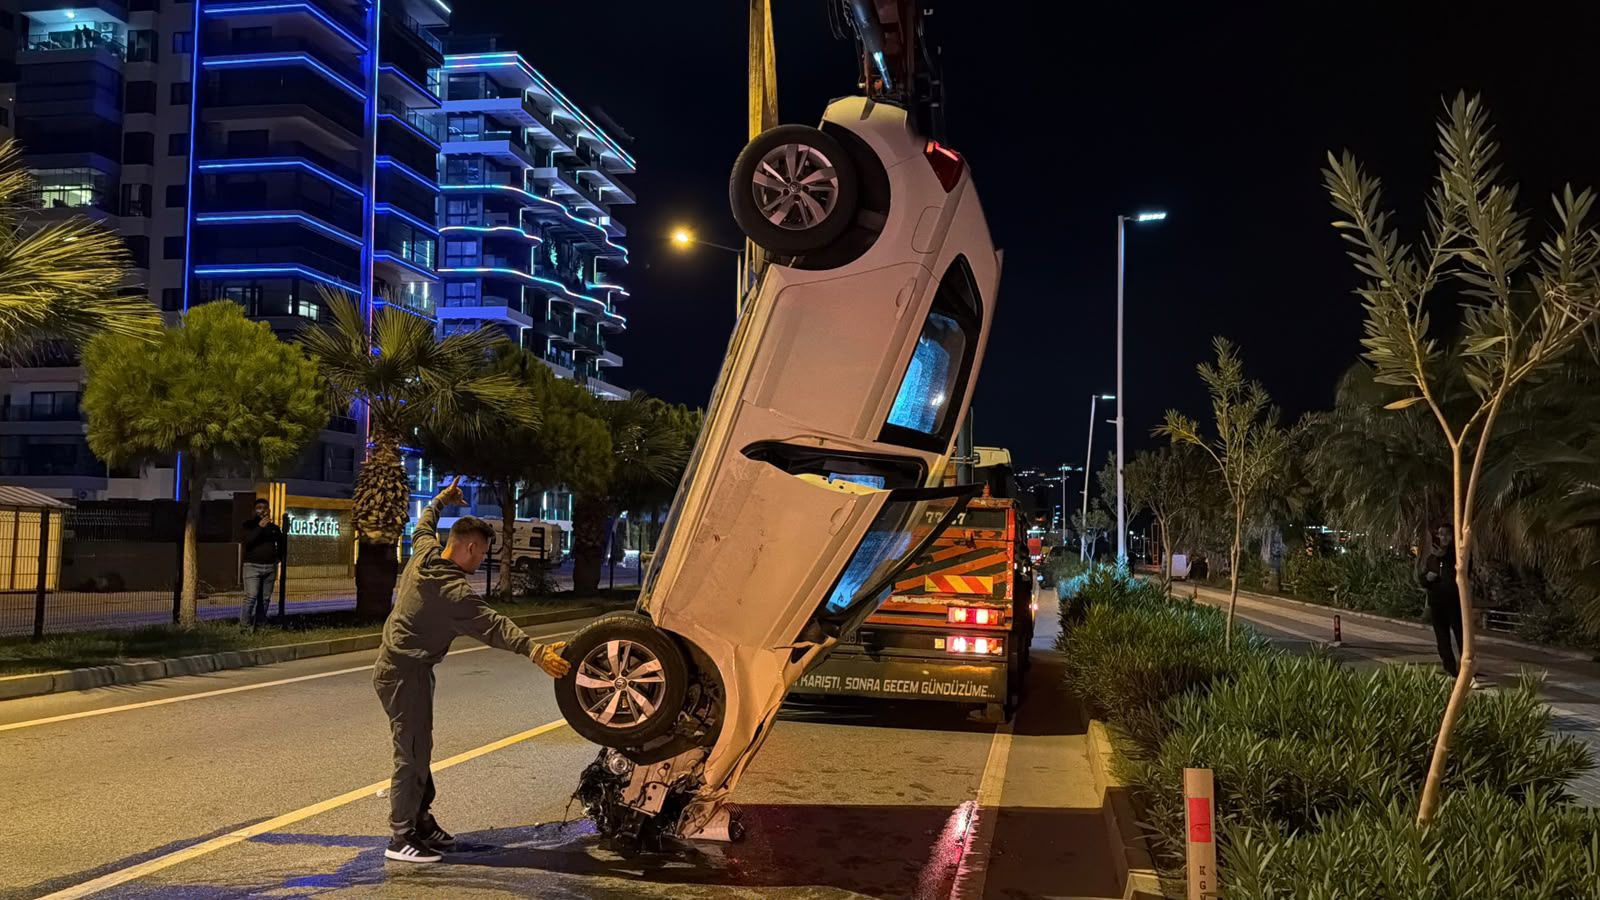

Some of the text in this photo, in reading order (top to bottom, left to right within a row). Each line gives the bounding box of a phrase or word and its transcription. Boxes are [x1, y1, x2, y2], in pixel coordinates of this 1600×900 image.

[844, 677, 881, 692] SONRA
[883, 679, 920, 694] GECEM
[921, 678, 996, 699] GÜNDÜZÜME...
